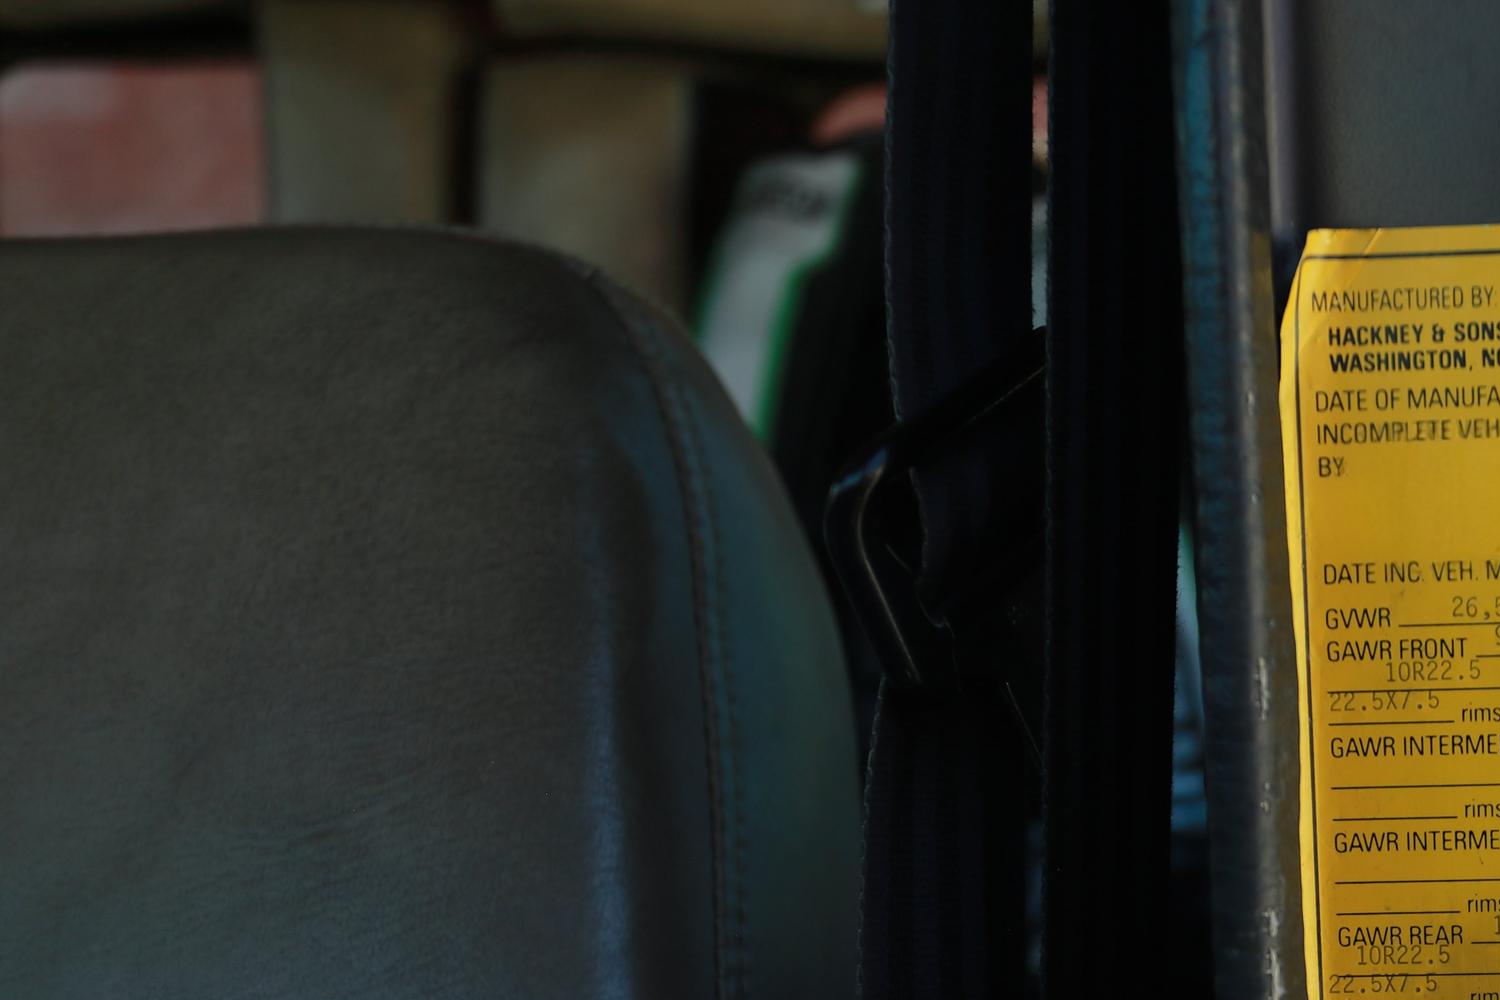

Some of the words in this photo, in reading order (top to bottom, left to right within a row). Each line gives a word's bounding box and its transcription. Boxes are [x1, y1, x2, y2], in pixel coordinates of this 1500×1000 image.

[1311, 286, 1465, 313] MANUFACTURED
[1471, 285, 1498, 308] BY:
[1328, 324, 1423, 346] HACKNEY
[1432, 324, 1445, 342] &
[1329, 350, 1474, 373] WASHINGTON,
[1315, 388, 1368, 412] DATE
[1375, 387, 1402, 410] OF
[1316, 419, 1452, 445] INCOMPLETE
[1324, 563, 1377, 584] DATE
[1383, 562, 1425, 583] INC.
[1435, 561, 1479, 581] VEH.
[1325, 608, 1391, 629] GVWR
[1327, 639, 1392, 662] GAWR
[1400, 637, 1466, 660] FRONT
[1386, 660, 1481, 682] 10R22.5
[1330, 690, 1440, 713] 22.5X7.5
[1330, 736, 1395, 758] GAWR
[1338, 925, 1402, 948] GAWR
[1410, 925, 1463, 945] REAR
[1358, 943, 1450, 966] 10R22.5
[1329, 972, 1438, 994] 22.5X7.5
